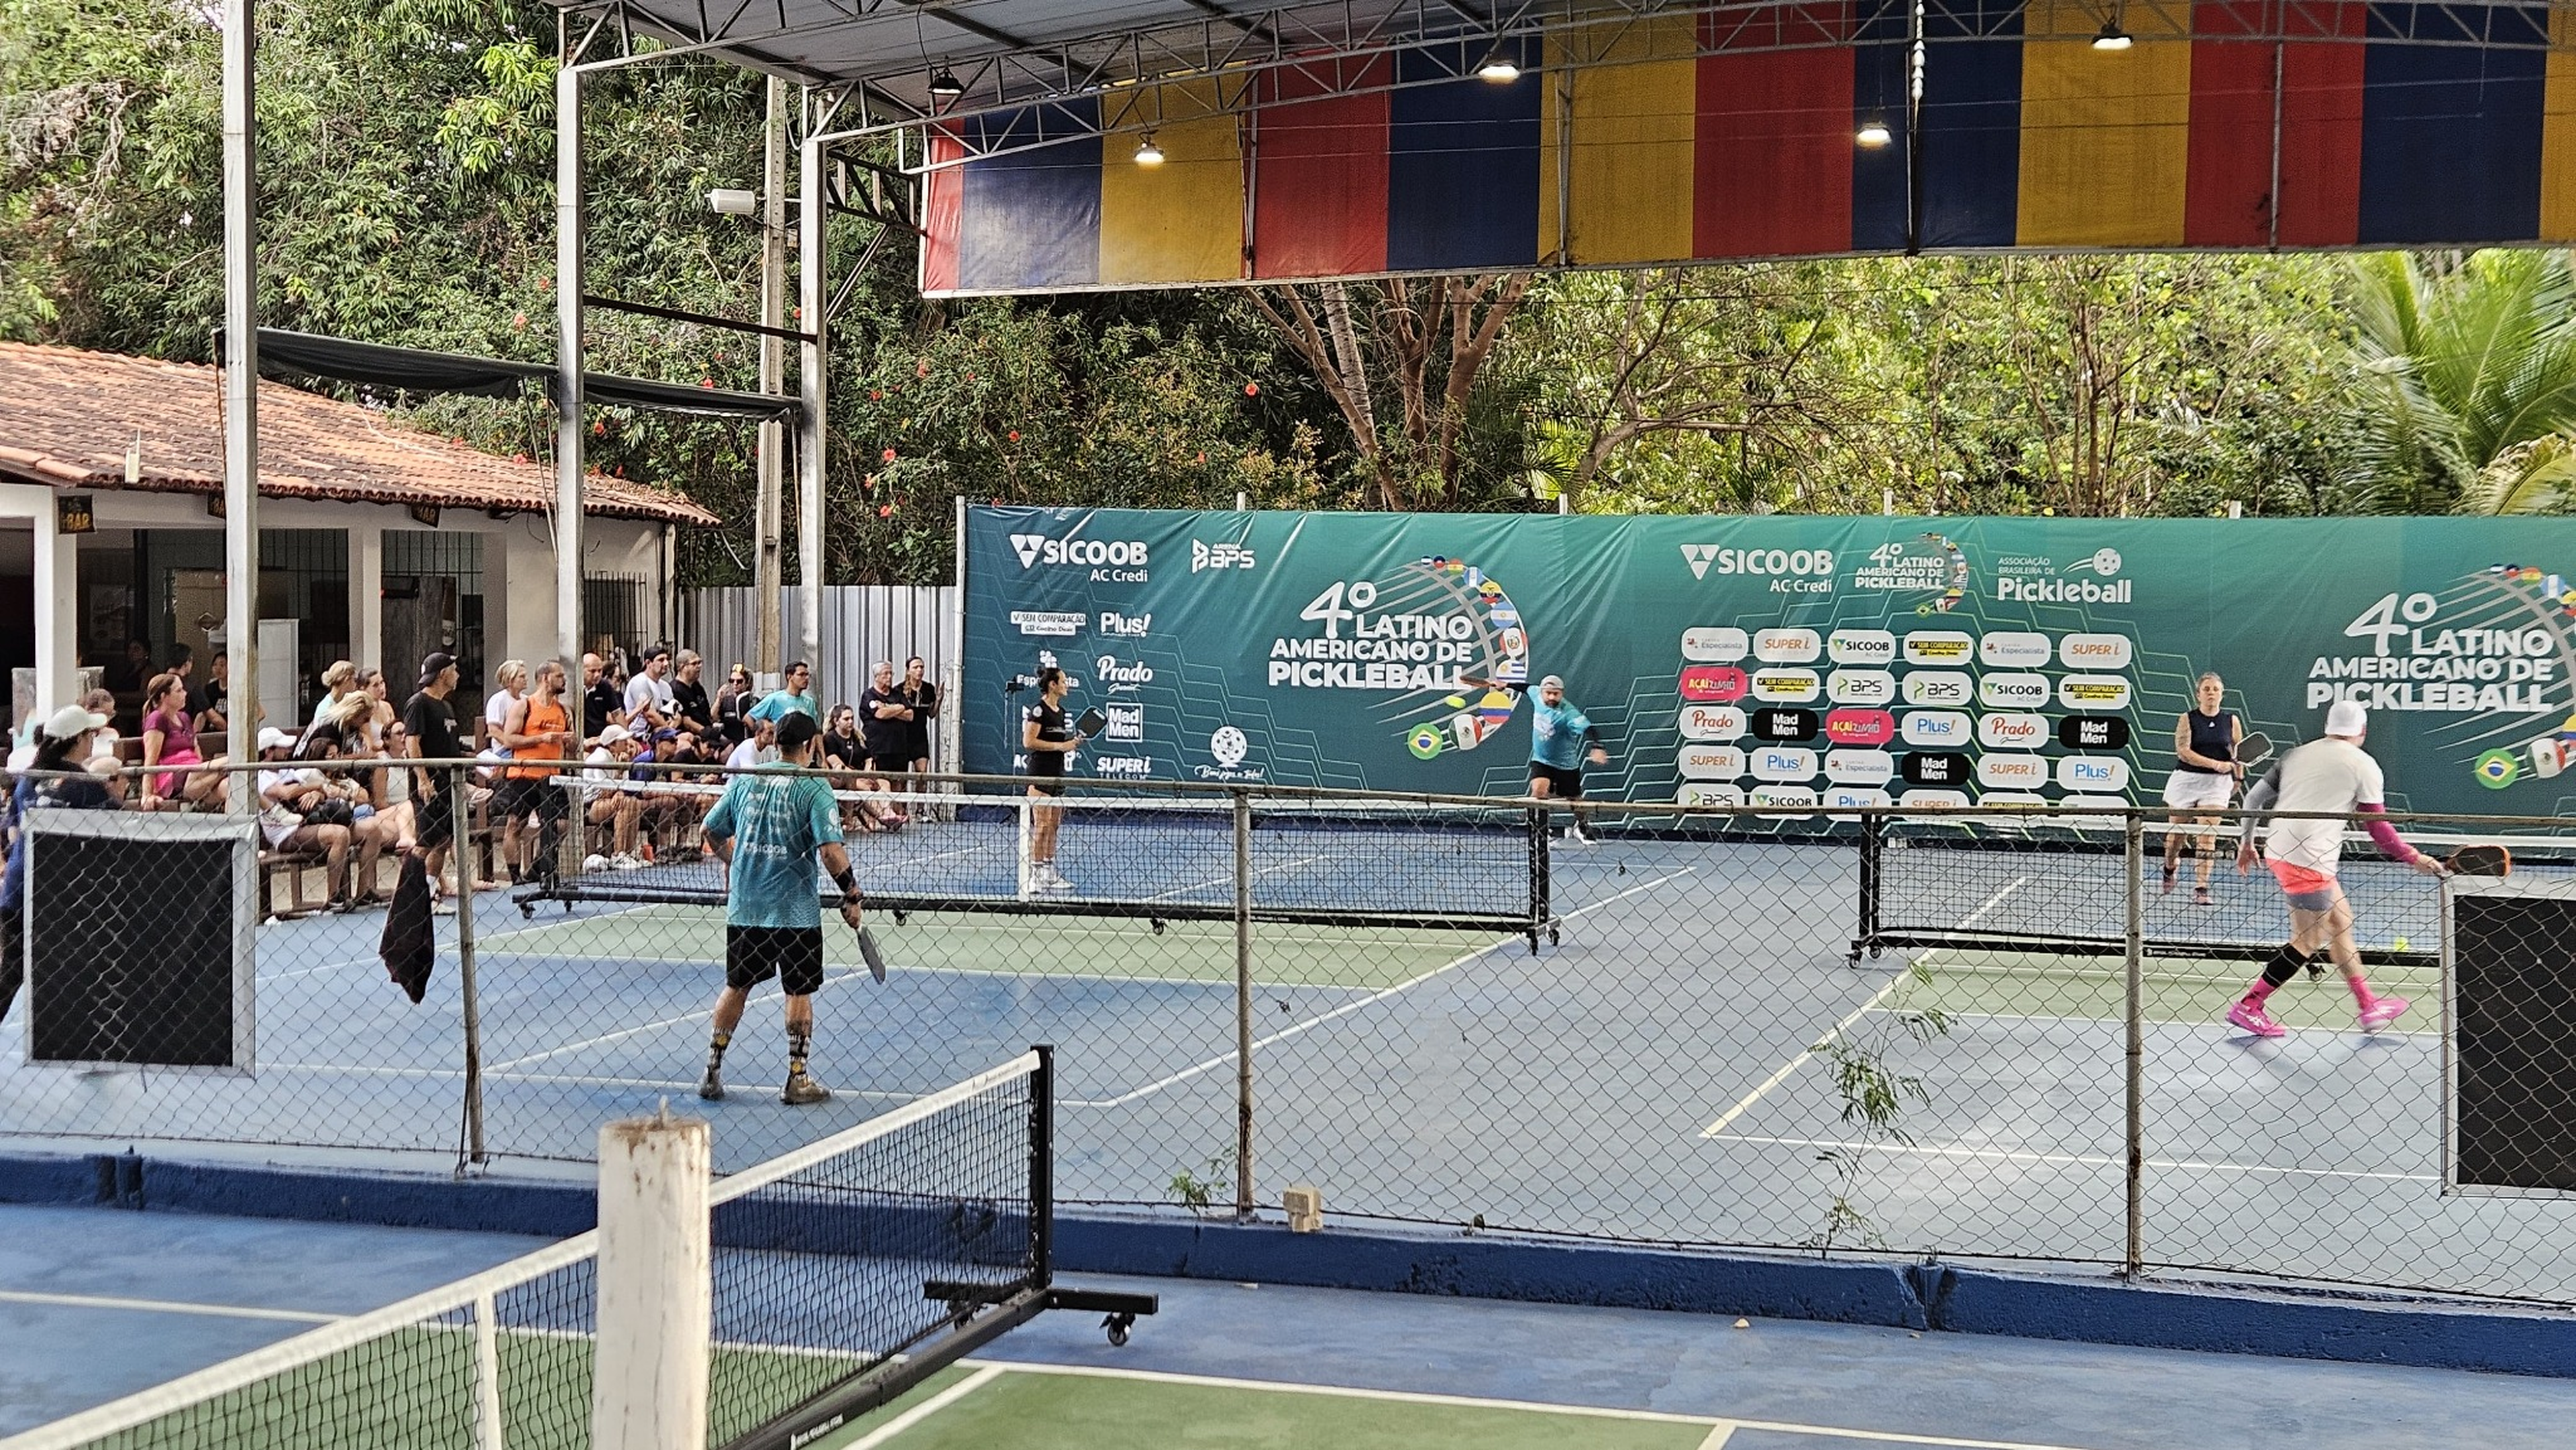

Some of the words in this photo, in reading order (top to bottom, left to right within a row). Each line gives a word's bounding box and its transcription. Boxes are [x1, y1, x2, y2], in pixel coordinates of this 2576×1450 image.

[66, 512, 91, 530] BAR
[1043, 540, 1148, 565] SICOOB
[1717, 549, 1833, 575] SICOOB
[1892, 557, 1945, 568] LATINO
[1998, 557, 2050, 566] ASSOCIAÇÃO
[1090, 569, 1109, 581] AC
[1112, 569, 1148, 582] Credi
[1856, 567, 1925, 576] AMERICANO
[1928, 569, 1944, 577] DE
[1998, 566, 2042, 574] BRASILEIRA
[1770, 579, 1790, 592] AC
[1794, 579, 1832, 593] Credi
[1855, 577, 1944, 588] PICKLEBALL
[1998, 576, 2131, 603] Pickleball
[1101, 612, 1151, 637] Plus!
[1356, 614, 1473, 640] LATINO
[1764, 638, 1802, 649] SUPER
[1845, 641, 1890, 651] SICOOB
[2072, 644, 2111, 655] SUPER
[2411, 629, 2554, 657] LATINO
[1270, 638, 1430, 662] AMERICANO
[1436, 641, 1472, 662] DE
[1097, 655, 1153, 682] Prado
[2308, 657, 2502, 679] AMERICANO
[2509, 658, 2554, 681] DE
[1269, 661, 1472, 690] PICKLEBALL
[1851, 680, 1882, 692] BPS
[1928, 683, 1960, 696] BPS
[1997, 685, 2043, 695] SICOOB
[2306, 681, 2554, 712] PICKLEBALL
[1109, 708, 1140, 724] Mad
[1692, 710, 1733, 727] Prado
[1772, 713, 1799, 725] Mad
[1109, 722, 1140, 737] Men
[1772, 724, 1798, 736] Men
[1917, 718, 1956, 735] Plus!
[1991, 716, 2035, 735] Prado
[2080, 720, 2108, 733] Mad
[2080, 732, 2108, 744] Men
[1690, 755, 1727, 766] SUPER
[1768, 755, 1805, 771] Plus!
[1921, 757, 1947, 769] Mad
[1921, 768, 1947, 780] Men
[1989, 764, 2029, 775] SUPER
[2075, 764, 2115, 781] Plus!
